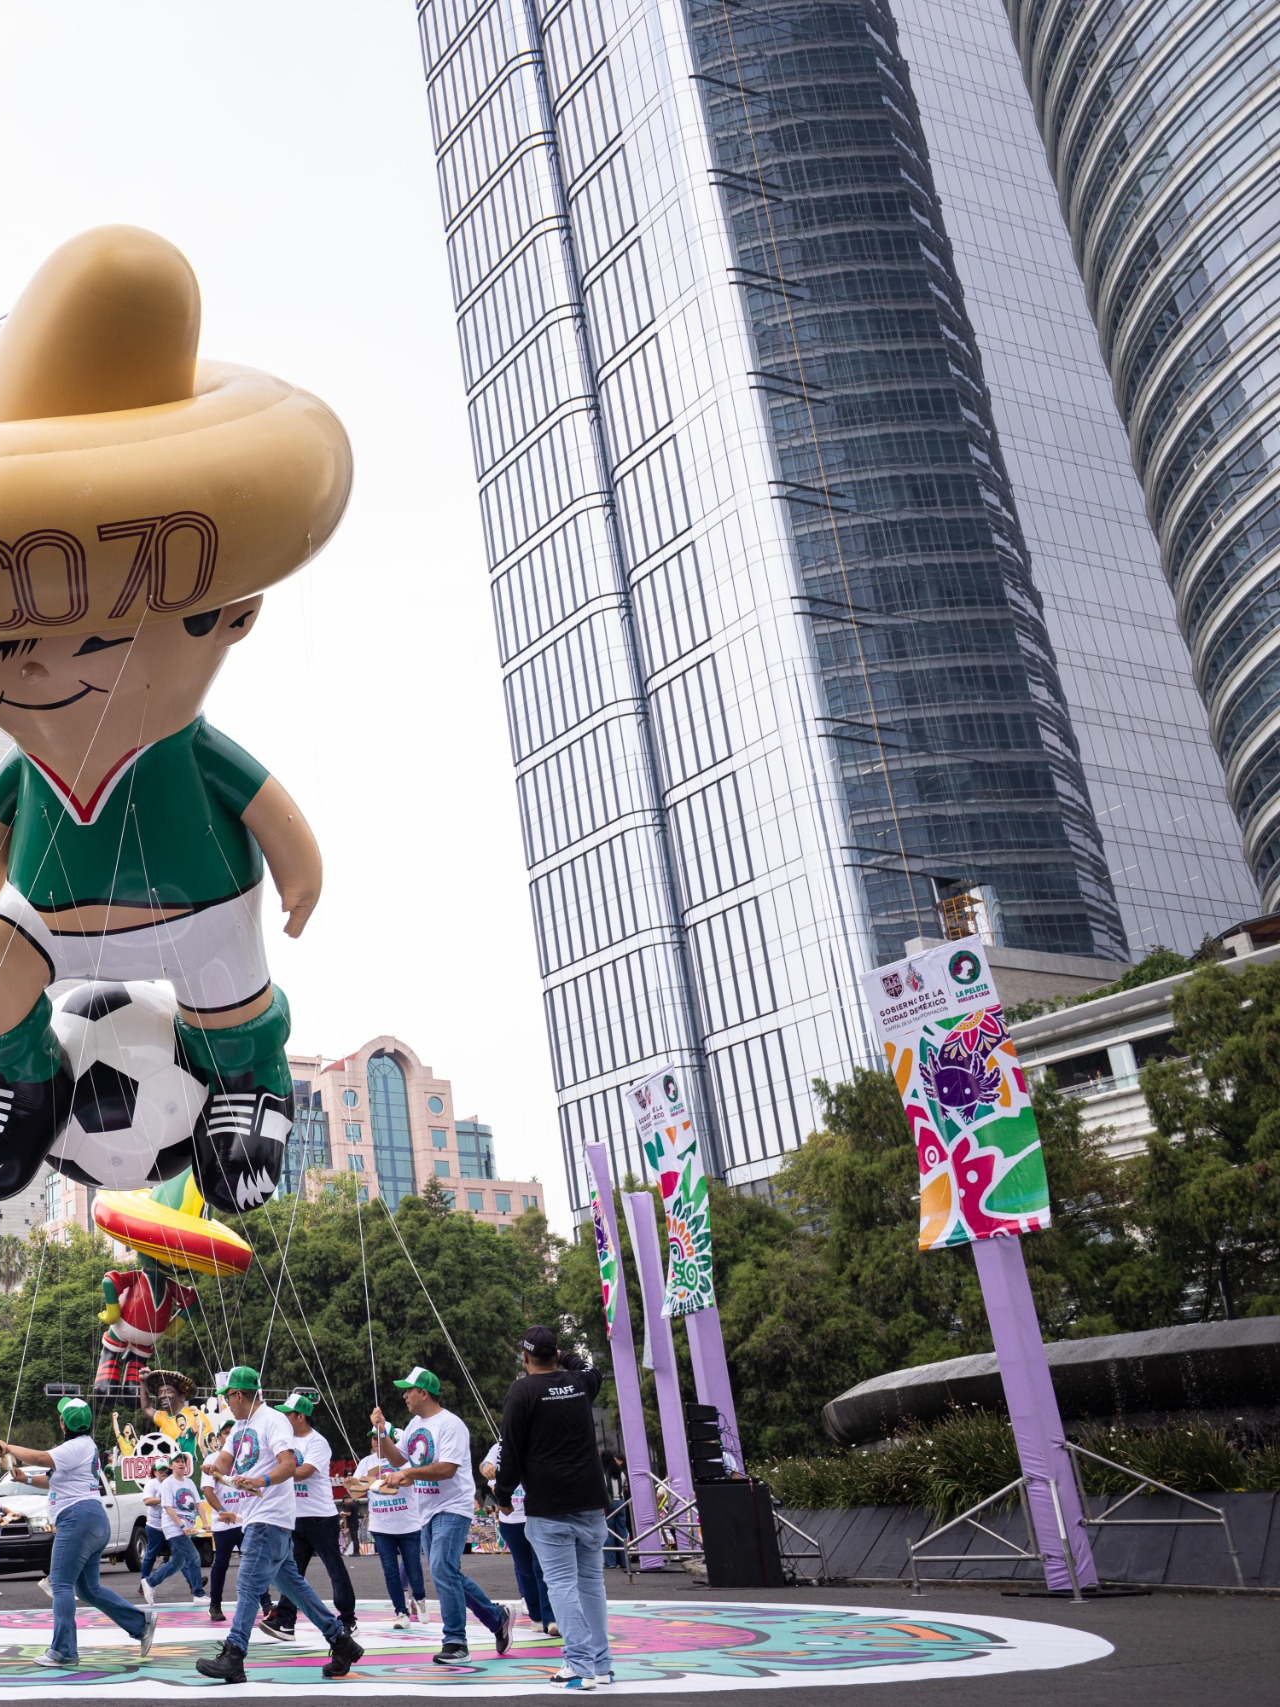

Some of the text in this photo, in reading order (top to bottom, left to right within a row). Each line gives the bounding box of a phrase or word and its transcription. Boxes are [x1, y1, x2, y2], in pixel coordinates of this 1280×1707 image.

[96, 511, 219, 619] 70
[918, 993, 930, 1002] DE
[932, 989, 944, 998] LA
[955, 983, 989, 998] LA PELOTA
[978, 990, 991, 998] CASA
[882, 1011, 908, 1026] CIUDAD
[909, 1007, 919, 1016] DE
[548, 1385, 575, 1396] STAFF
[422, 1487, 440, 1495] CASA
[379, 1497, 407, 1507] PELOTA
